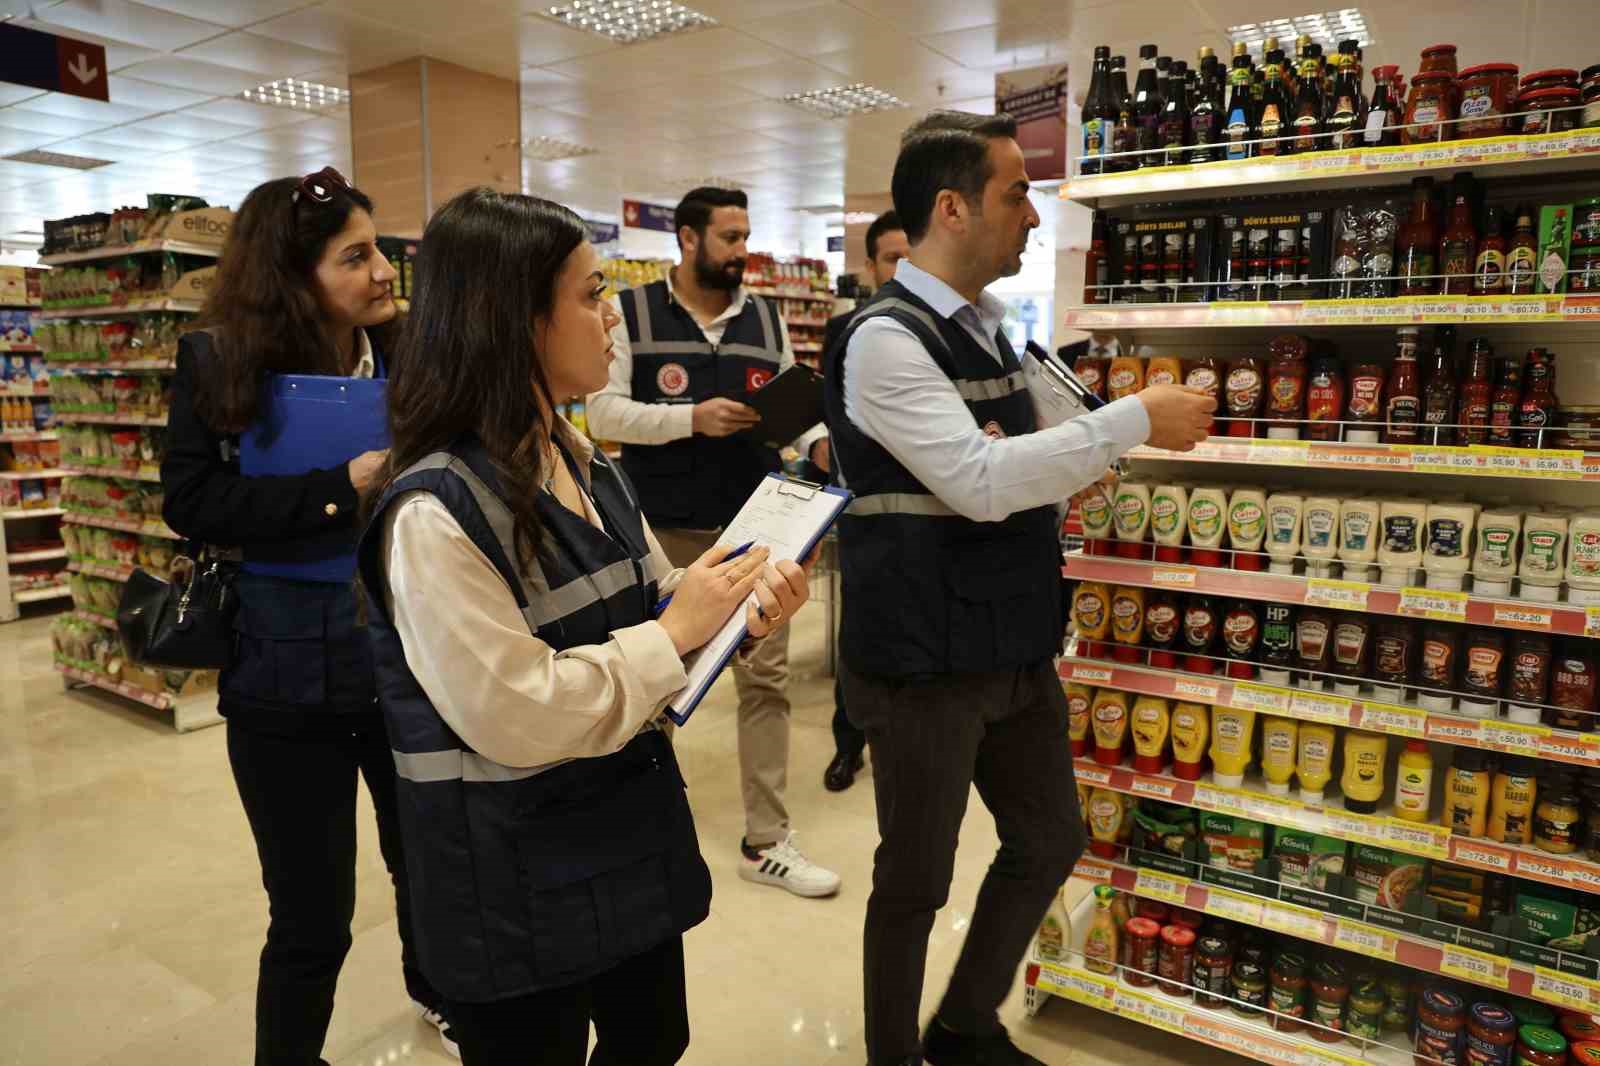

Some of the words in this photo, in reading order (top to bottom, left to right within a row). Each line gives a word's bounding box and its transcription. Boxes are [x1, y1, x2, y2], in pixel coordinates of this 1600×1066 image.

[183, 215, 229, 234] elifoo
[1243, 215, 1269, 225] DÜNYA
[1270, 215, 1300, 224] SOSLARI
[1266, 607, 1289, 621] HP
